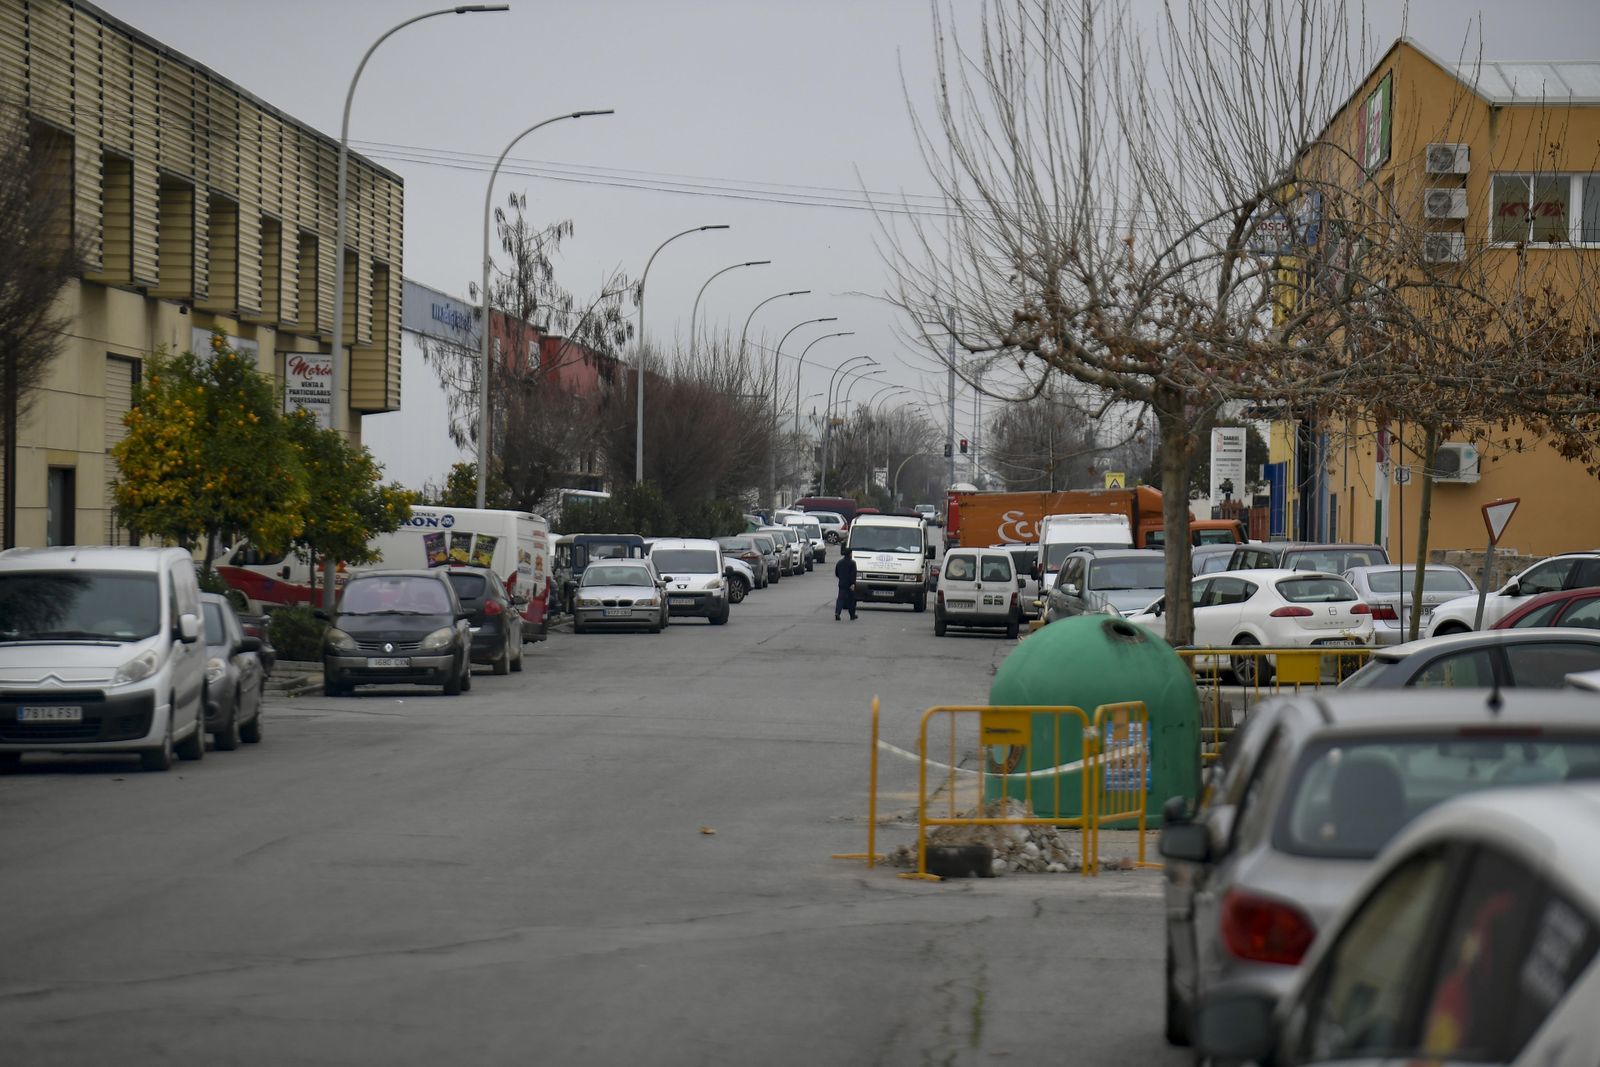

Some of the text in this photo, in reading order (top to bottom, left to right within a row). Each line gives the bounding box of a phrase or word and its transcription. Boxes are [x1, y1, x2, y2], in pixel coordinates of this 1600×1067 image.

[1498, 202, 1565, 217] KYB
[288, 388, 331, 396] PARTICULARES
[399, 516, 439, 528] RON
